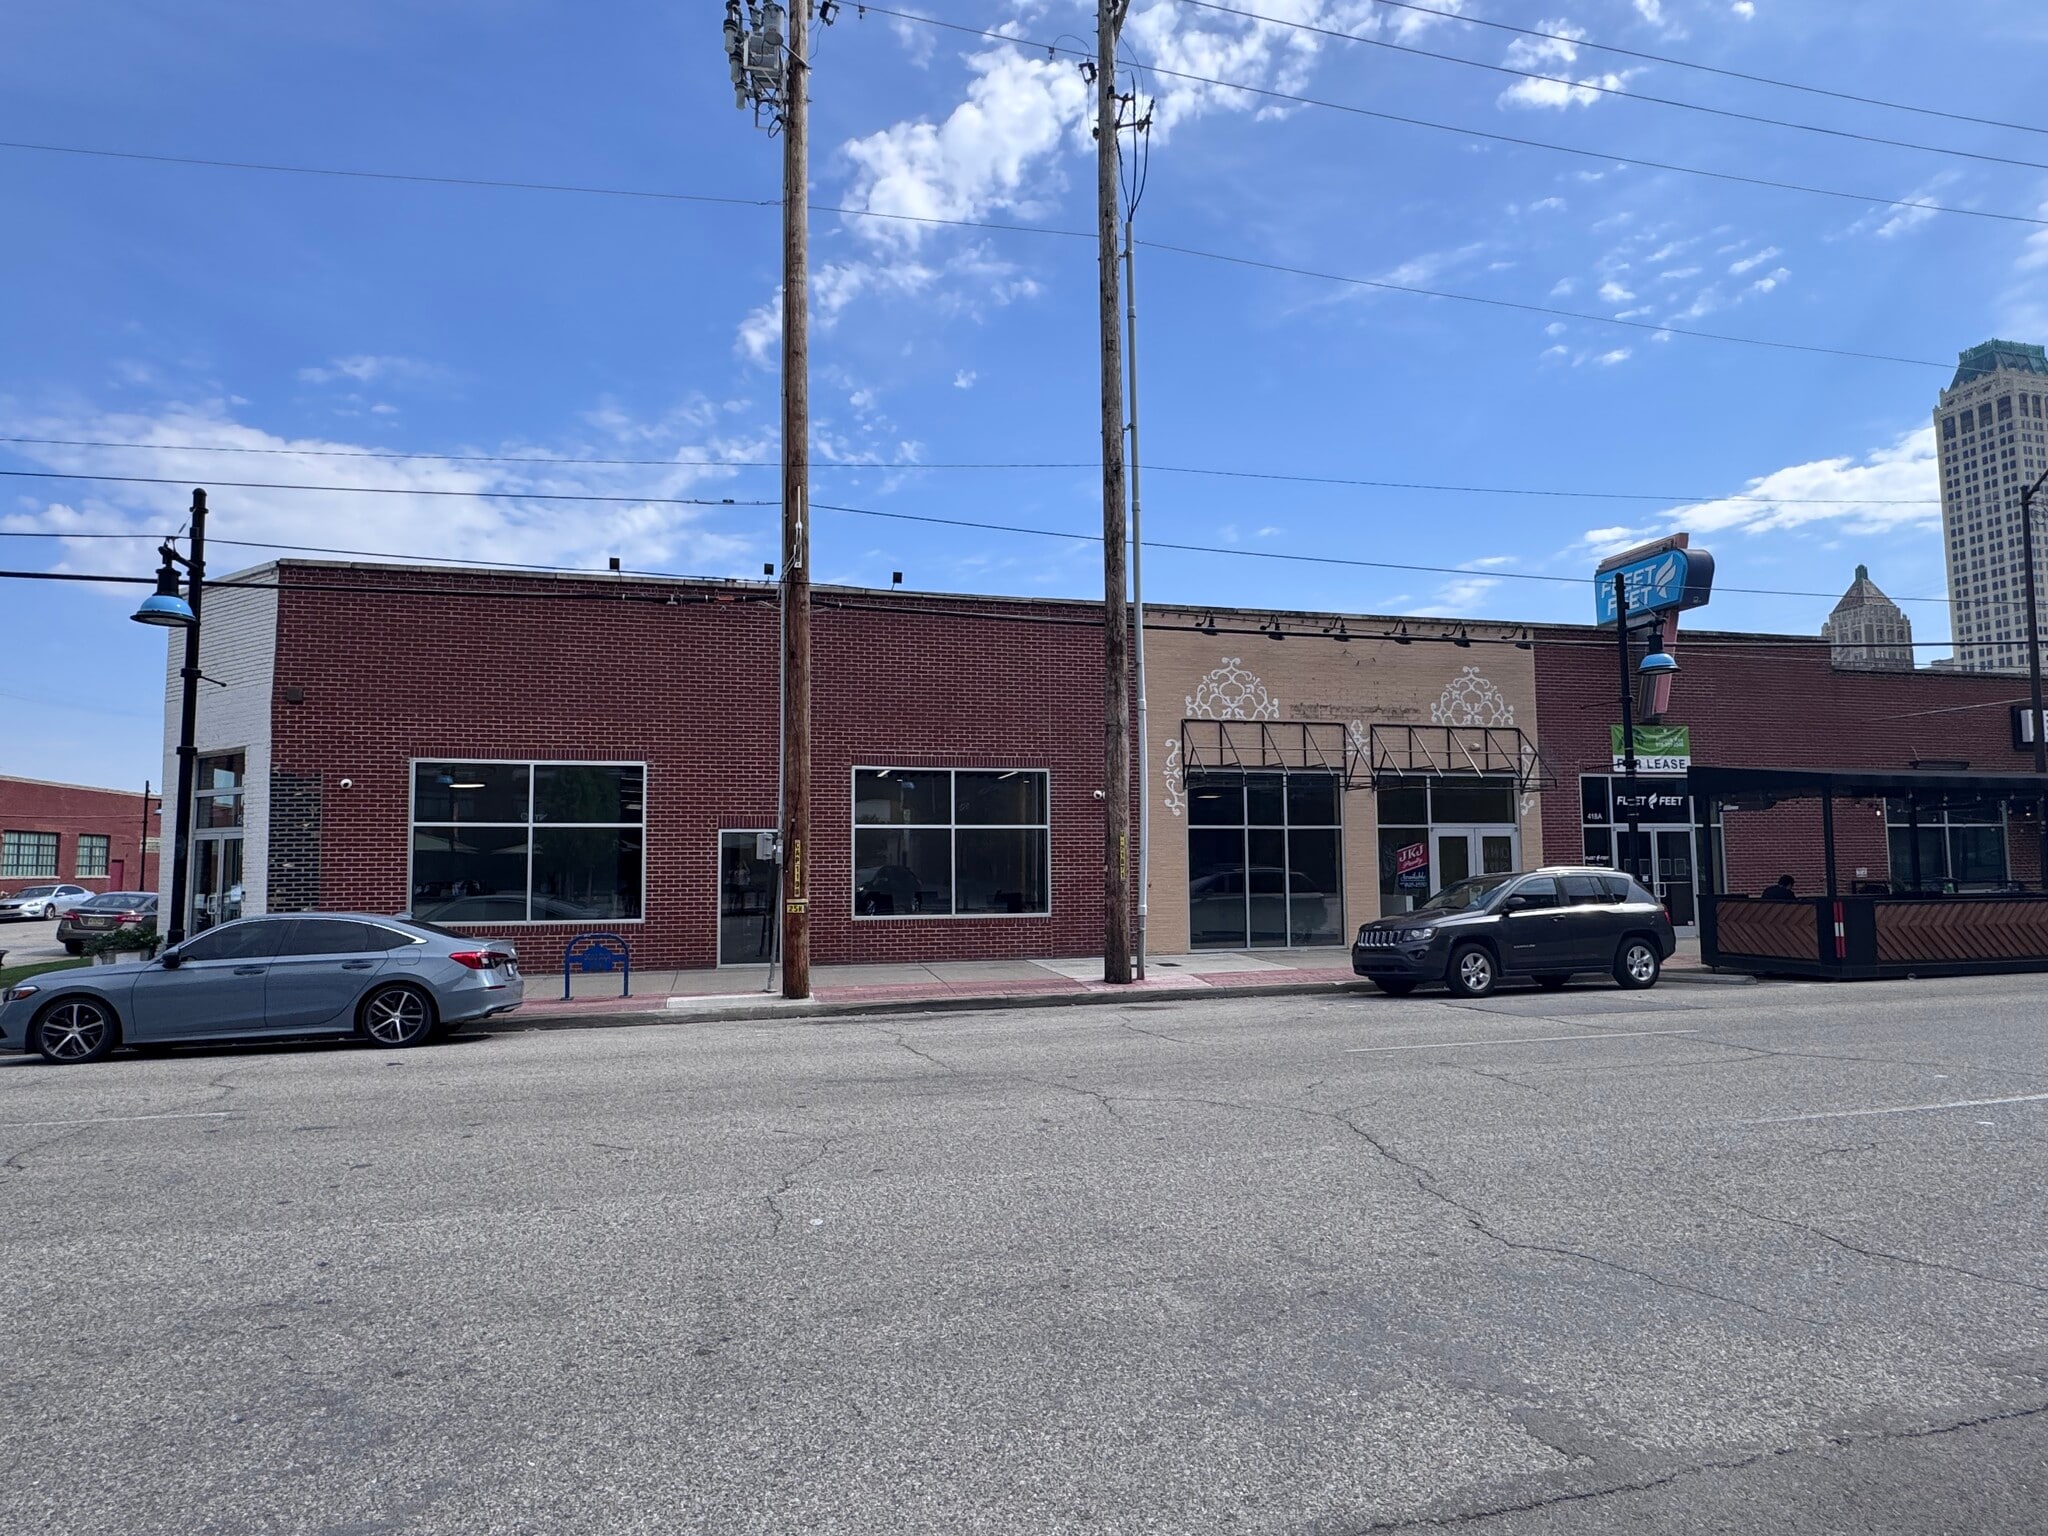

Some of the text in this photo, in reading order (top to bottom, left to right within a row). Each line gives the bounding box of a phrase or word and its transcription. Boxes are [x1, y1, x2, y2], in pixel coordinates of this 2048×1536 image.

[1617, 758, 1686, 769] FR LEASE
[1616, 796, 1683, 806] FLET FEET
[1399, 845, 1424, 862] JKJ
